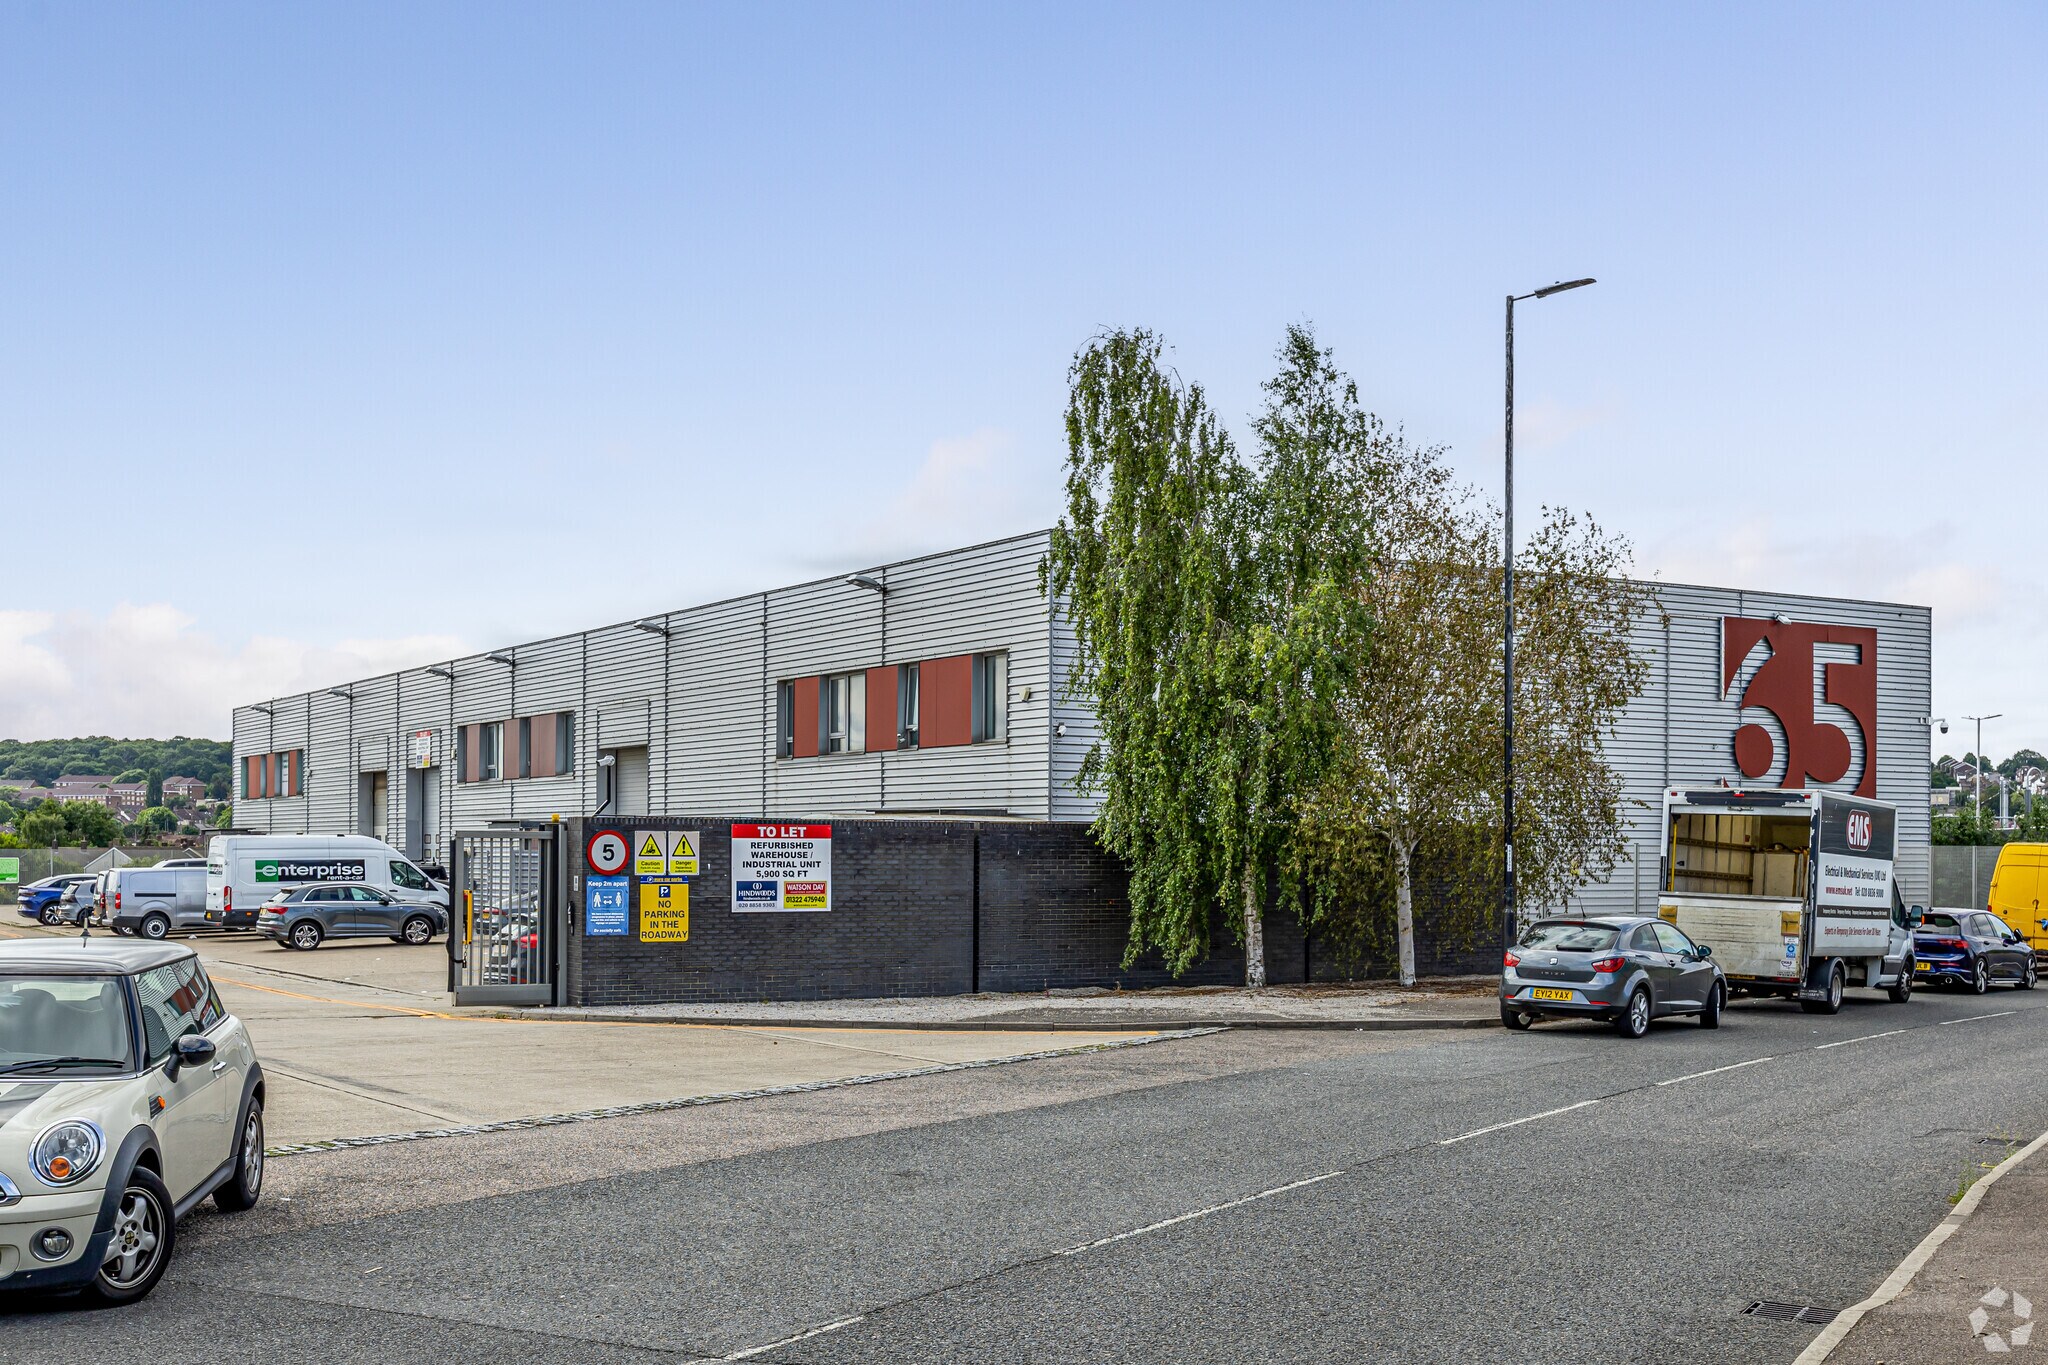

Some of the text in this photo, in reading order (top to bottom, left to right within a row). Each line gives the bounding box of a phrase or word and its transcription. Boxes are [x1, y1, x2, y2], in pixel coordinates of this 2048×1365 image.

[1723, 635, 1867, 796] 65
[758, 827, 806, 837] TO LET
[1849, 815, 1869, 846] EMS
[603, 844, 614, 861] 5
[800, 860, 821, 868] UNIT
[262, 863, 364, 878] enterprise
[756, 870, 808, 879] 5,900 SQ FT
[813, 883, 824, 891] DAY
[658, 900, 671, 908] NO
[644, 910, 685, 918] PARKING
[650, 920, 679, 928] IN THE
[641, 930, 688, 939] ROADWAY
[1535, 989, 1570, 999] EY12 YAX
